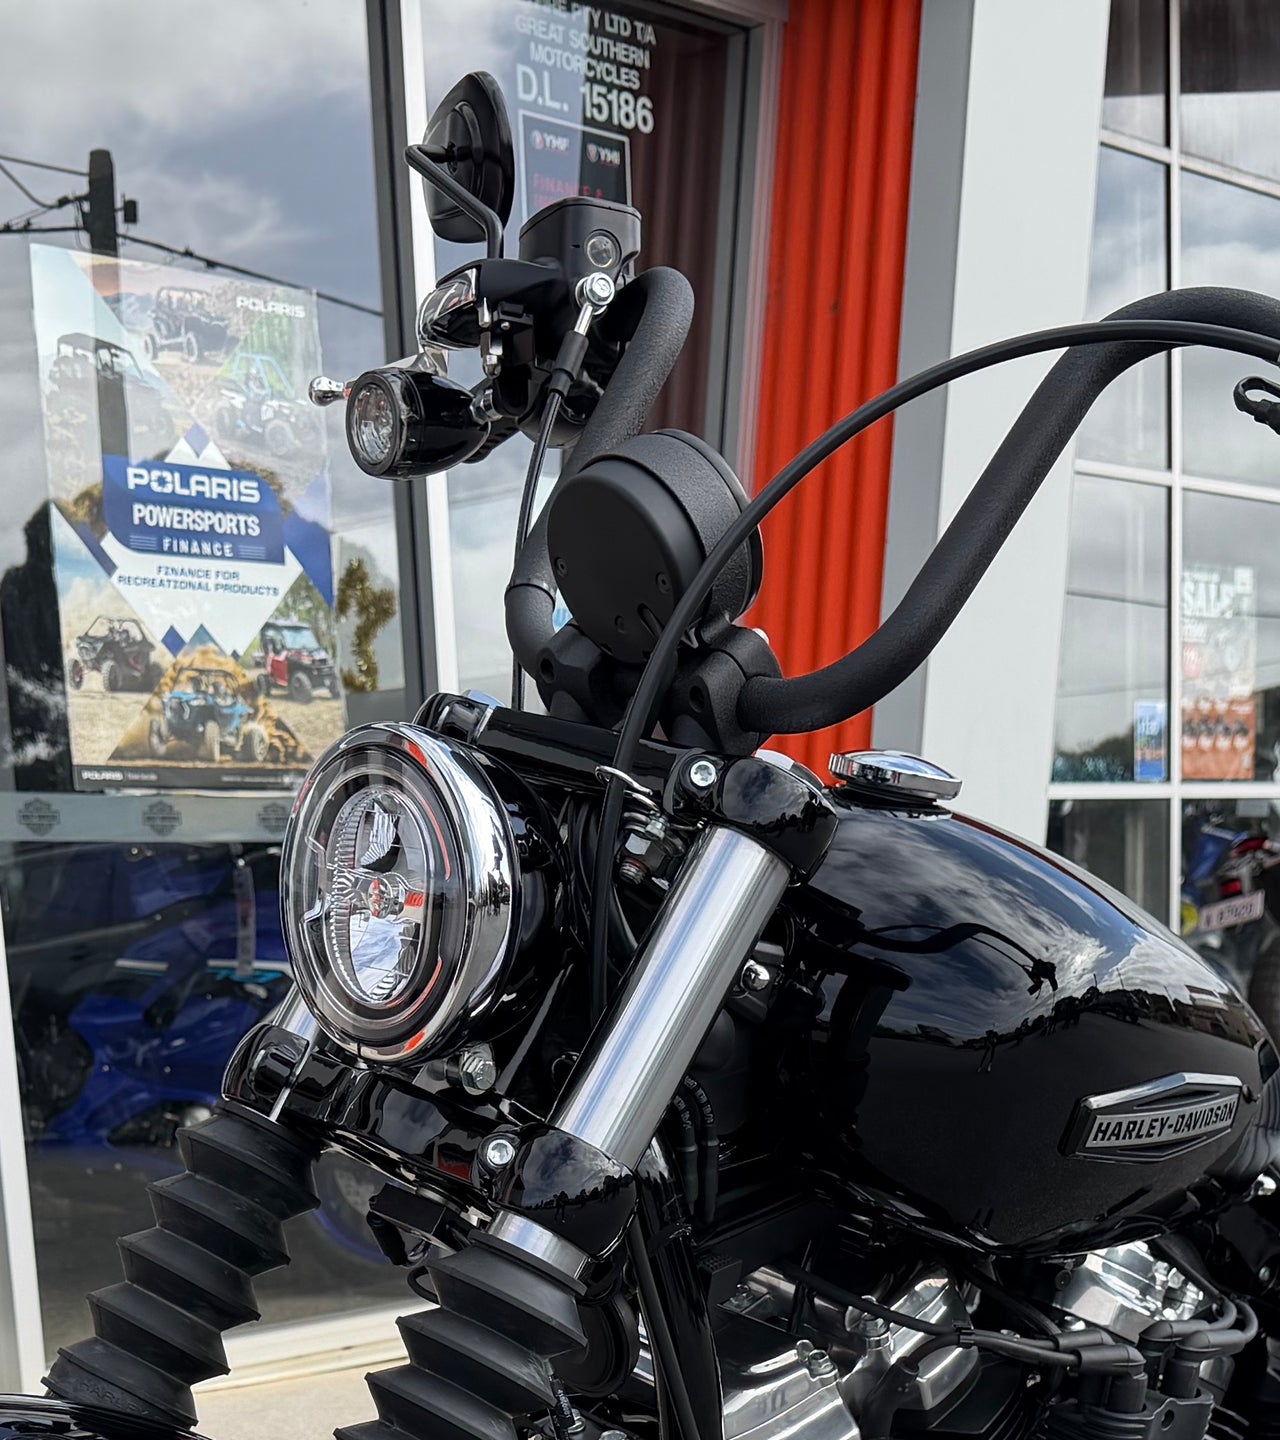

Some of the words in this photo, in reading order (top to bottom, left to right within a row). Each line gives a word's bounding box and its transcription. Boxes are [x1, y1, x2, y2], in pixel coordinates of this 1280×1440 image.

[515, 15, 565, 43] GREAT
[570, 29, 651, 69] SOUTHERN
[605, 13, 633, 37] LTD
[634, 20, 657, 45] T/A
[529, 42, 640, 90] MOTORCYCLES
[516, 63, 569, 112] D.L.
[580, 81, 655, 134] 15186
[236, 296, 306, 318] POLARIS
[126, 467, 261, 503] POLARIS
[132, 503, 261, 536] POWERSPORTS
[162, 537, 234, 558] FINANCE
[118, 575, 212, 592] RECREATIONAL
[214, 583, 280, 597] PRODUCTS
[156, 565, 212, 580] FINANCE
[215, 569, 240, 581] FOR
[1091, 1101, 1237, 1142] HARLEY-DAVIDSON
